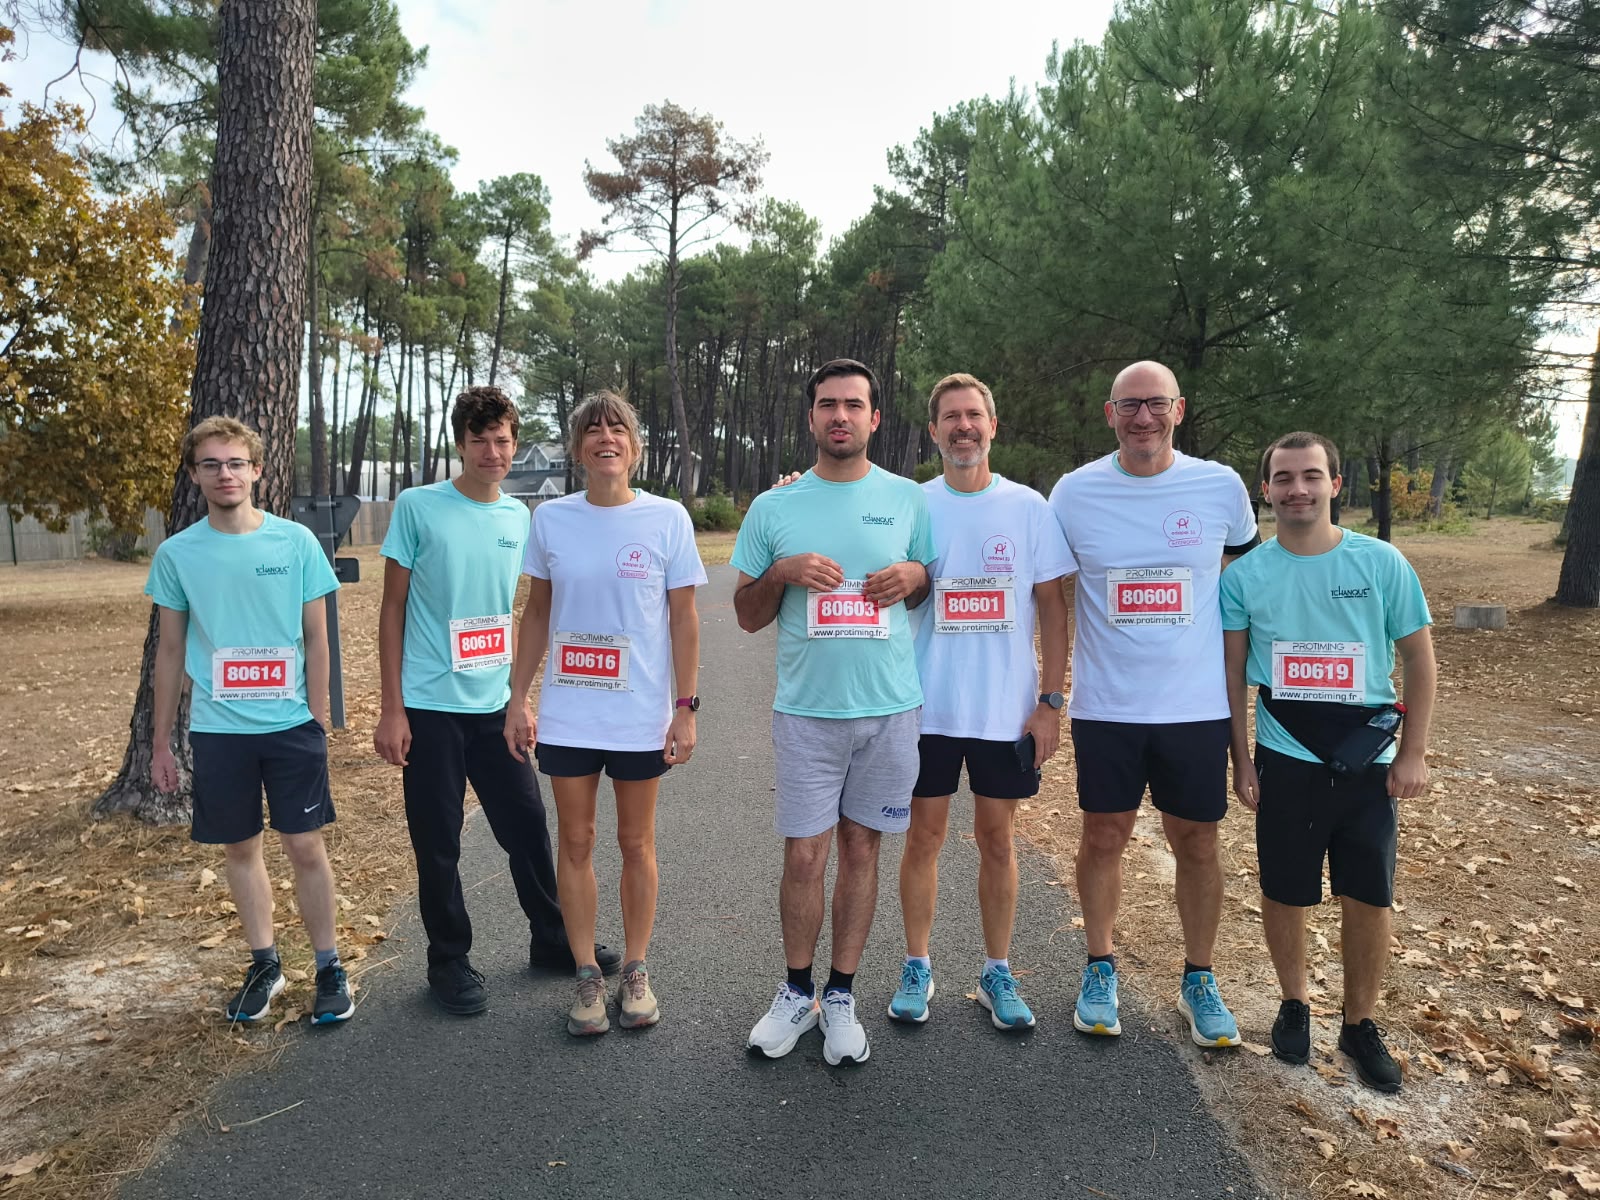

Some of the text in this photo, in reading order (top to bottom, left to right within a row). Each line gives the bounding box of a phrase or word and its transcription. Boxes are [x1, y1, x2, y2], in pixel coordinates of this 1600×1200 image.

[1125, 568, 1174, 577] PROTIMING
[951, 577, 997, 586] PROTIMING
[1122, 588, 1178, 605] 80600
[821, 600, 875, 617] 80603
[948, 596, 999, 613] 80601
[1114, 616, 1186, 625] www.protiming.fr
[941, 623, 1009, 632] www.protiming.fr
[569, 632, 614, 642] PROTIMING
[813, 628, 883, 638] www.protiming.fr
[461, 633, 502, 652] 80617
[1292, 642, 1345, 651] PROTIMING
[231, 647, 279, 656] PROTIMING
[565, 651, 616, 670] 80616
[227, 665, 282, 681] 80614
[1287, 662, 1349, 681] 80619
[557, 677, 622, 690] www.protiming.fr
[219, 690, 289, 700] www.protiming.fr
[1279, 691, 1358, 702] www.protiming.fr
